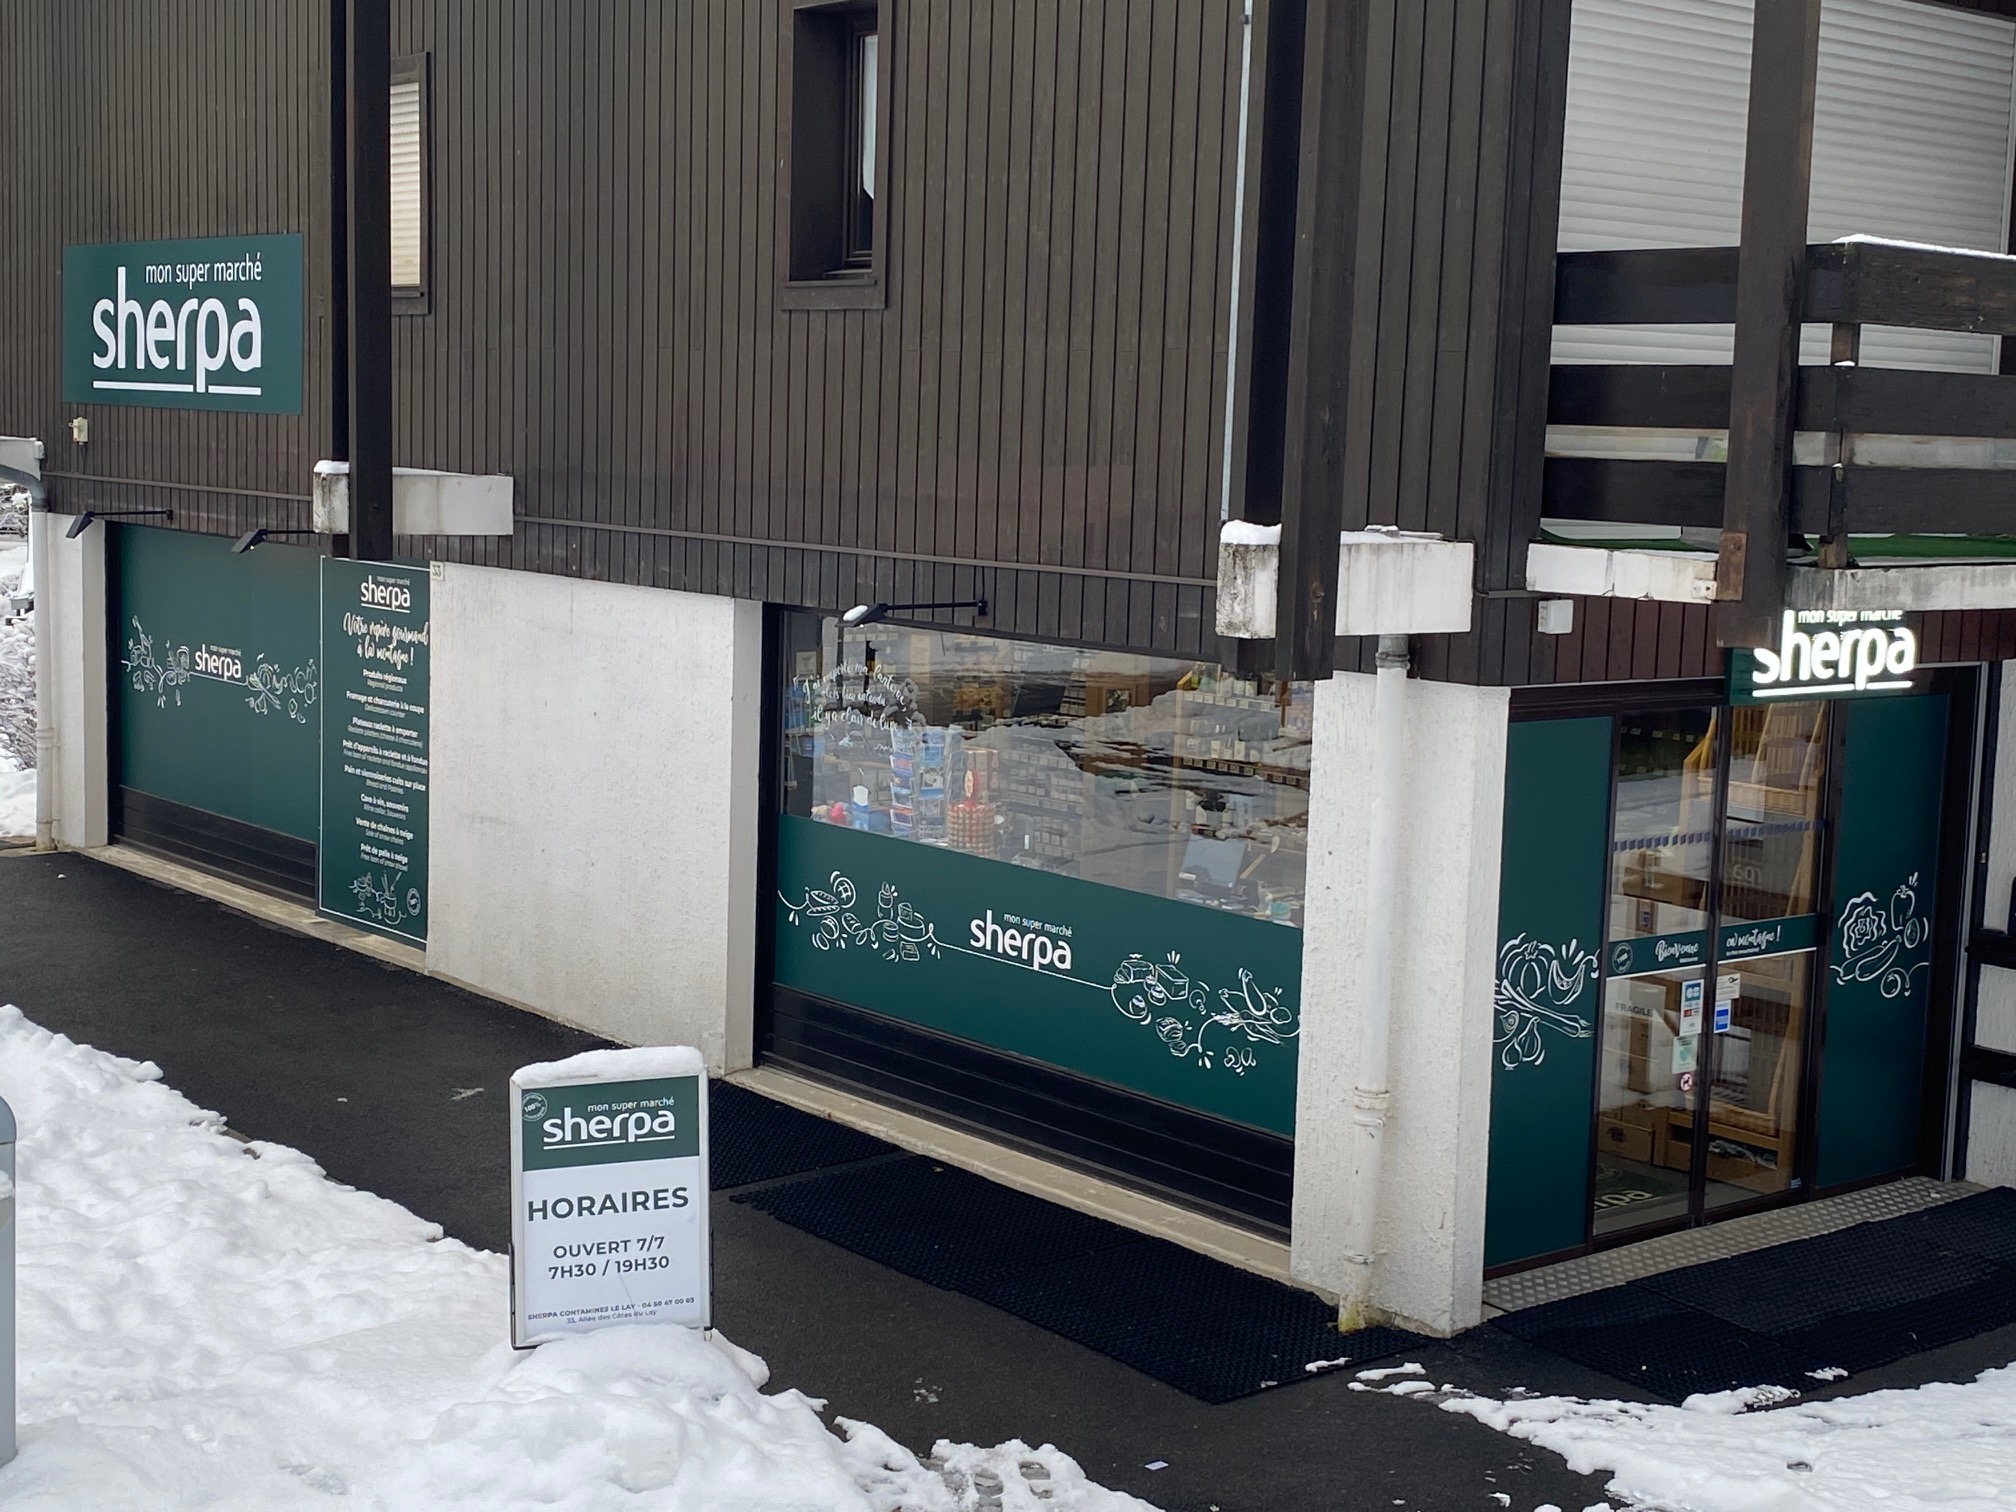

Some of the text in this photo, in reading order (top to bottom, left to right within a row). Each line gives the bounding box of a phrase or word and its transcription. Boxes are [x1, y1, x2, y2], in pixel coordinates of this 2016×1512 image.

[145, 252, 262, 290] mon super marché
[93, 266, 262, 393] sherpa
[361, 574, 410, 611] sherpa
[1797, 610, 1825, 624] mon
[1826, 610, 1858, 627] super
[195, 643, 242, 682] sherpa
[1752, 609, 1916, 691] sherpa
[1003, 913, 1072, 937] mon super marché
[970, 909, 1072, 971] sherpa
[1615, 1001, 1653, 1017] FRAGILE
[588, 1096, 675, 1113] mon super marché
[543, 1107, 675, 1142] sherpa
[528, 1187, 689, 1221] HORAIRES
[553, 1235, 665, 1258] OUVERT 7/7
[549, 1256, 670, 1279] 7H30 / 19H30
[528, 1312, 558, 1320] SHERPA
[560, 1306, 609, 1317] CONTAMINES
[612, 1311, 632, 1319] Côtes
